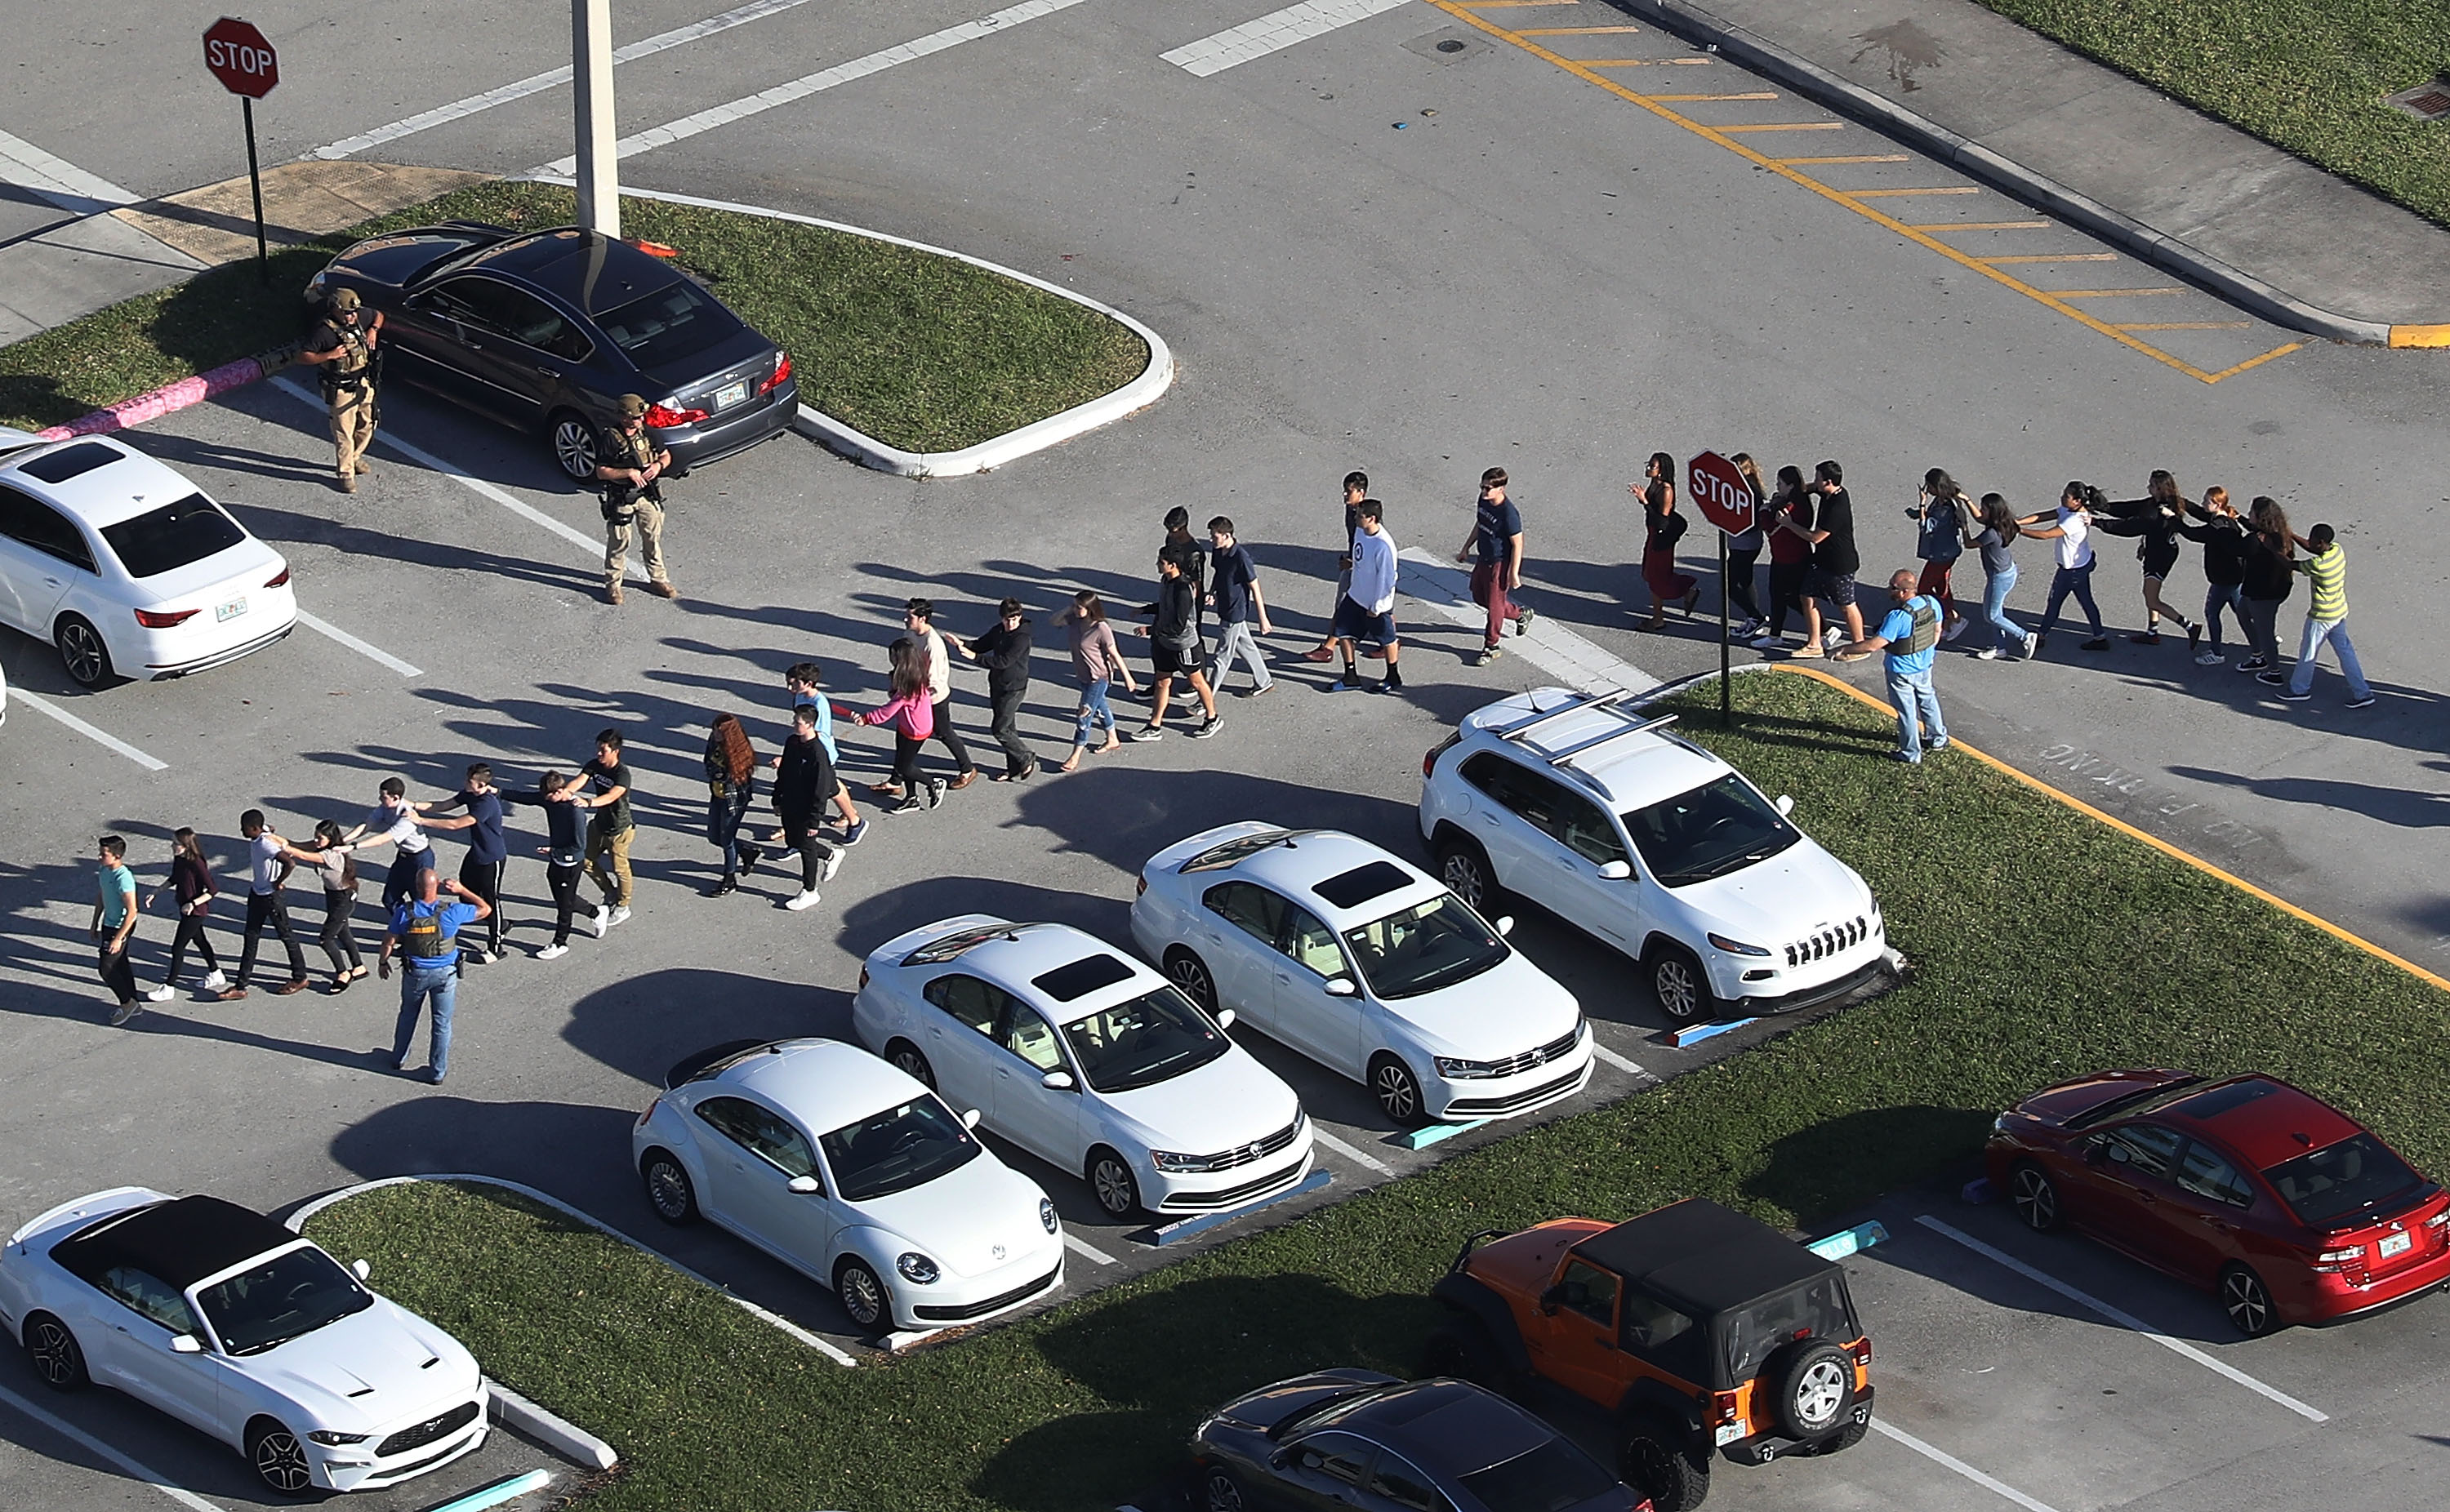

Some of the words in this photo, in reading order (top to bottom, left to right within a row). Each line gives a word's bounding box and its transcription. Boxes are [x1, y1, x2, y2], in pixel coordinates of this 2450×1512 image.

[209, 39, 272, 76] STOP
[1693, 469, 1749, 515] STOP
[2039, 743, 2198, 816] PRKING
